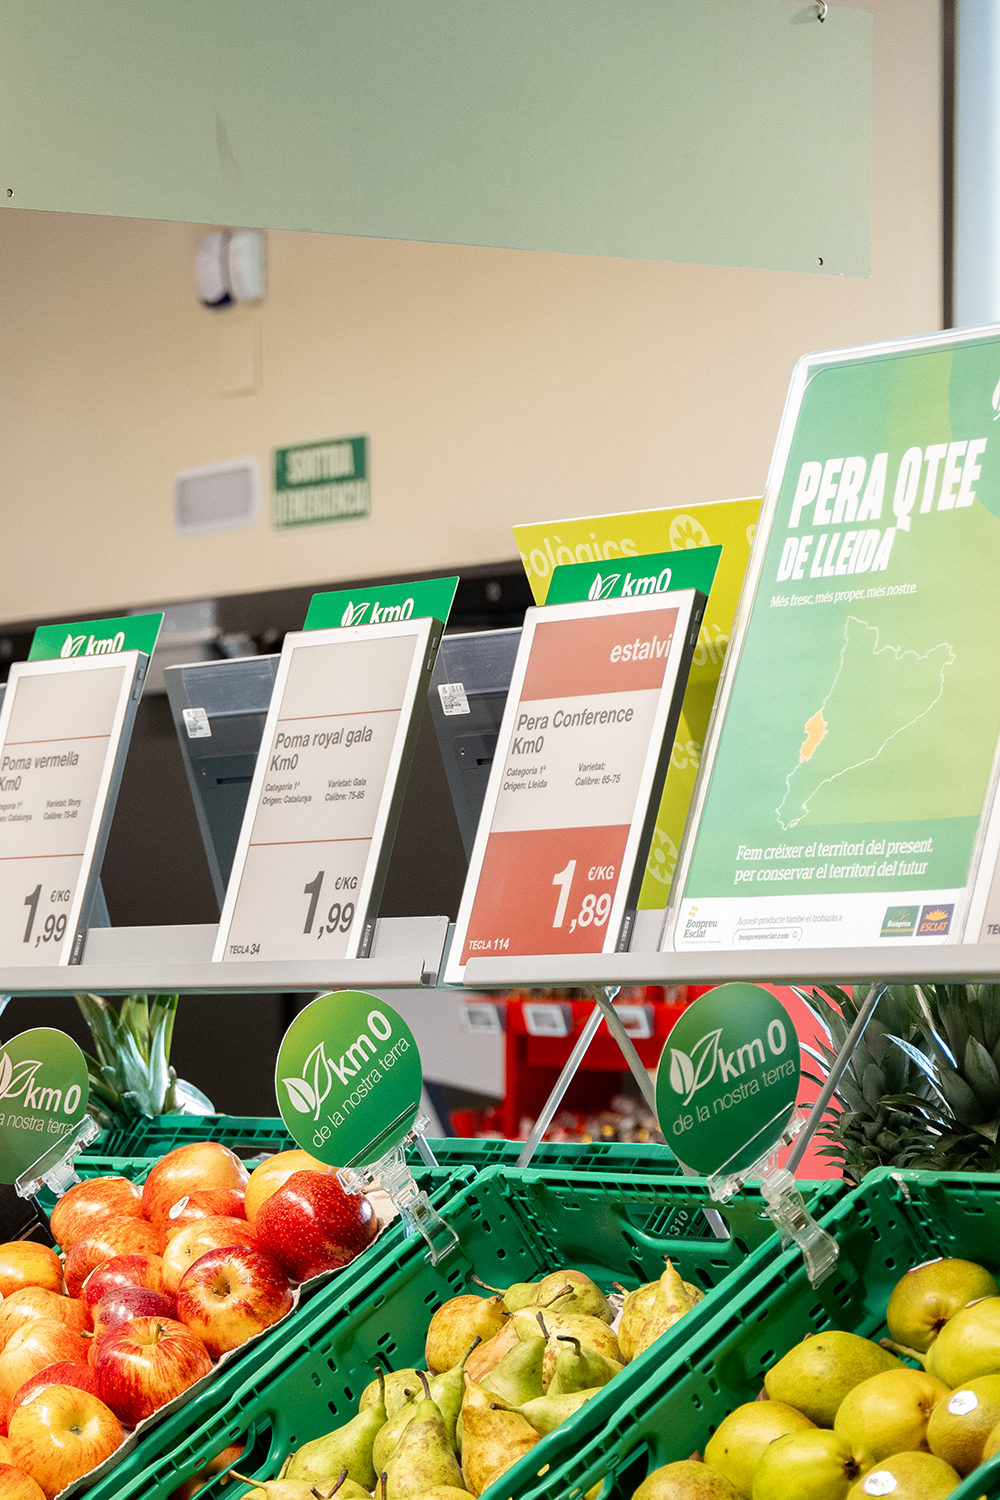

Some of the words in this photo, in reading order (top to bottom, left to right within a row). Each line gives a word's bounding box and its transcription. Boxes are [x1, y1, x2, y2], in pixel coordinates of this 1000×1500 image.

[788, 452, 888, 529] PERA
[892, 438, 988, 532] QTEE
[776, 535, 814, 582] DE
[809, 527, 897, 579] LLEIDA
[621, 568, 672, 597] km0
[770, 595, 789, 608] Més
[789, 592, 814, 606] fresc,
[814, 591, 833, 605] més
[832, 588, 866, 605] proper,
[866, 585, 885, 598] més
[886, 583, 917, 596] nostre.
[369, 598, 414, 624] km0
[85, 632, 125, 655] km0
[610, 634, 672, 663] estalvi
[517, 713, 549, 731] Pera
[552, 708, 634, 728] Conference
[275, 732, 310, 749] Poma
[312, 728, 344, 749] royal
[345, 726, 373, 748] gala
[511, 736, 544, 755] Km0
[1, 756, 32, 771] Poma
[34, 751, 79, 768] vermella
[270, 754, 299, 771] Km0
[578, 762, 606, 772] Varietat:
[507, 766, 537, 777] Categoria
[575, 776, 601, 786] Calibre:
[602, 774, 621, 784] 65-75
[265, 783, 292, 792] Categoria
[328, 779, 352, 788] Varietat:
[353, 778, 367, 787] Gala
[504, 781, 527, 791] Origen:
[528, 779, 547, 789] Lleida
[262, 796, 283, 806] Origen:
[284, 794, 312, 805] Catalunya
[325, 792, 347, 802] Calibre:
[735, 845, 763, 861] Fem
[763, 842, 804, 860] créixer
[805, 842, 816, 858] el
[817, 840, 865, 857] territori
[866, 839, 885, 855] del
[885, 838, 934, 857] present,
[588, 865, 615, 881] €/KG
[733, 868, 755, 885] per
[755, 866, 815, 881] conservar
[816, 863, 828, 879] el
[829, 862, 877, 879] territori
[877, 860, 897, 876] del
[896, 859, 929, 876] futur
[335, 877, 357, 890] €/KG
[50, 890, 71, 902] €/KG
[303, 871, 355, 939] 1,99
[552, 859, 613, 934] 1,89
[22, 884, 67, 948] 1,99
[686, 919, 718, 929] Bonpreu
[684, 929, 706, 938] Esclat
[920, 921, 948, 932] ESCLAT
[229, 945, 250, 954] TECLA
[250, 943, 261, 954] 34
[469, 940, 491, 950] TECLA
[493, 938, 510, 950] 114
[327, 1034, 378, 1086] km
[367, 1010, 392, 1041] 0
[718, 1038, 766, 1084] km
[767, 1019, 787, 1055] 0
[23, 1078, 62, 1112] km
[63, 1085, 81, 1114] 0
[312, 1125, 331, 1148] de
[327, 1112, 345, 1128] la
[342, 1069, 383, 1114] nostra
[378, 1037, 411, 1071] terra
